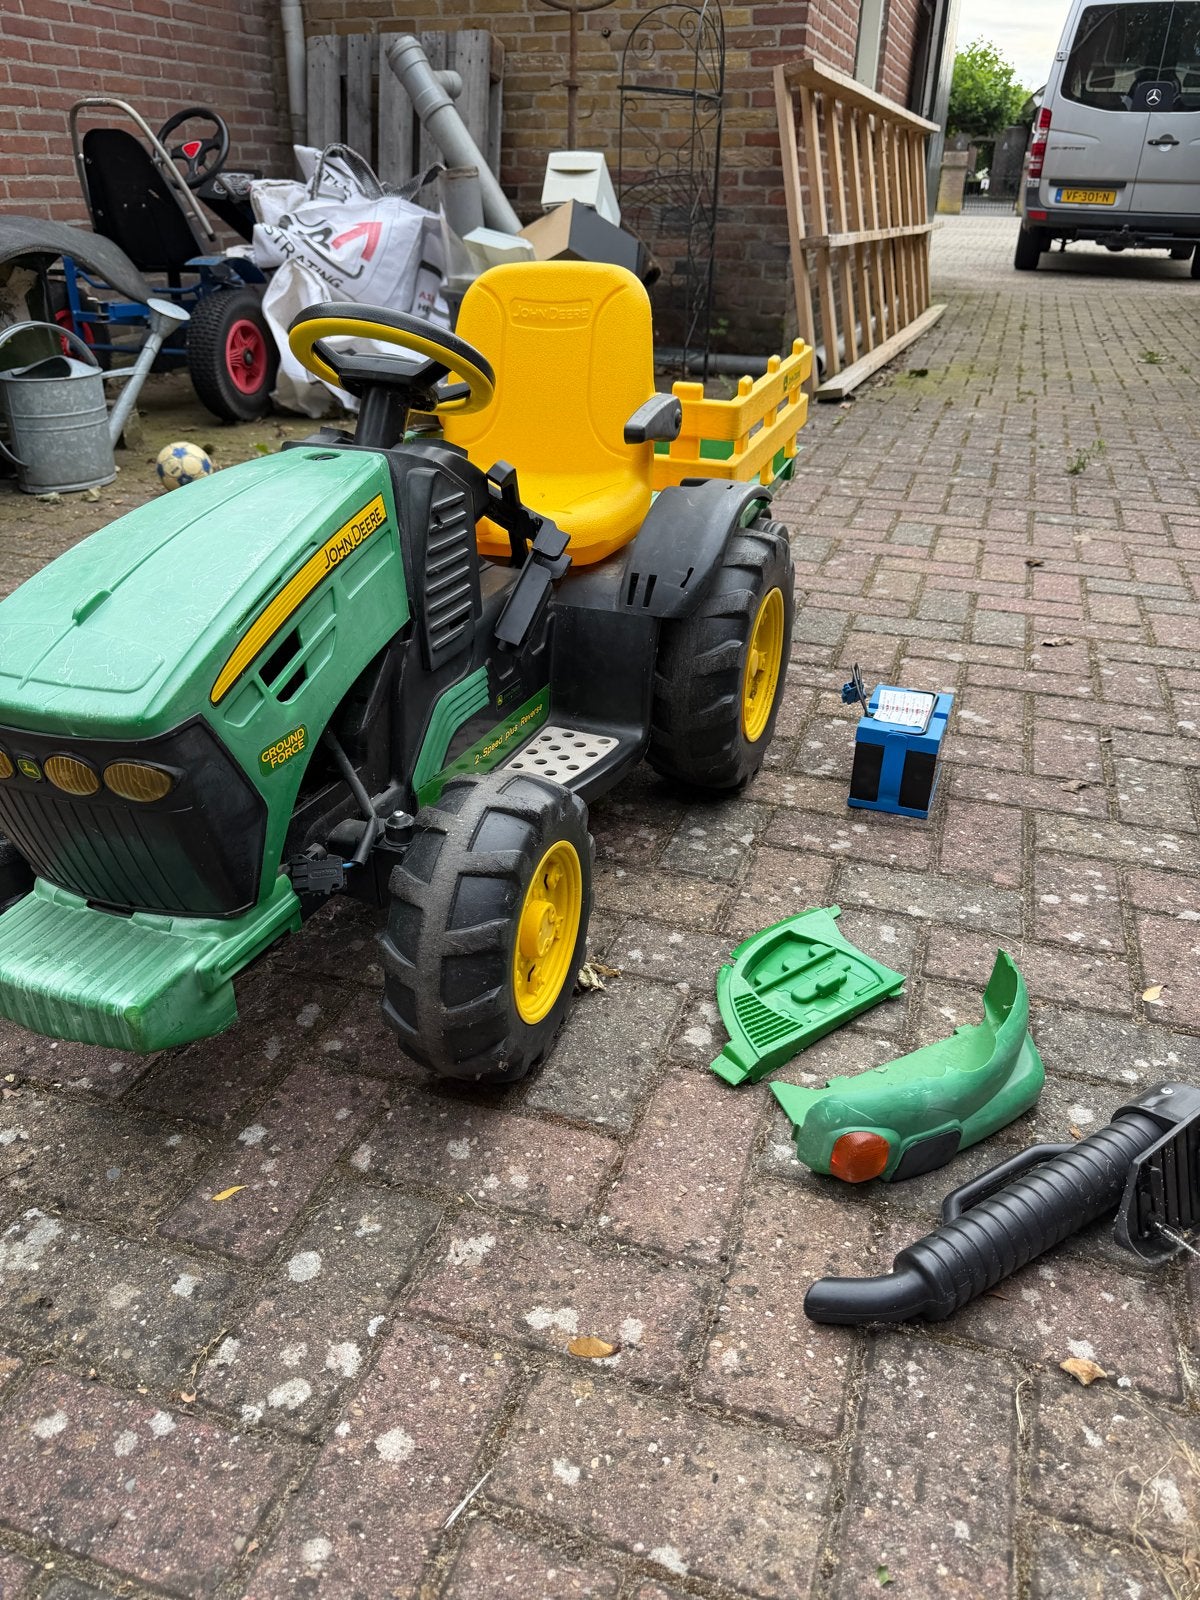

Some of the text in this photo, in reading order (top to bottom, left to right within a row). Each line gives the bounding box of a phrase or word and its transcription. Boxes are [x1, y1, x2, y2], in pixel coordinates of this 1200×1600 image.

[1066, 190, 1110, 202] VF-301-N
[513, 305, 589, 320] JOHN DEERE
[324, 507, 382, 569] JOHN DEERE
[261, 728, 305, 763] GROUND
[271, 739, 305, 768] FORCE
[475, 735, 503, 766] 2-Speed
[505, 724, 518, 741] plus
